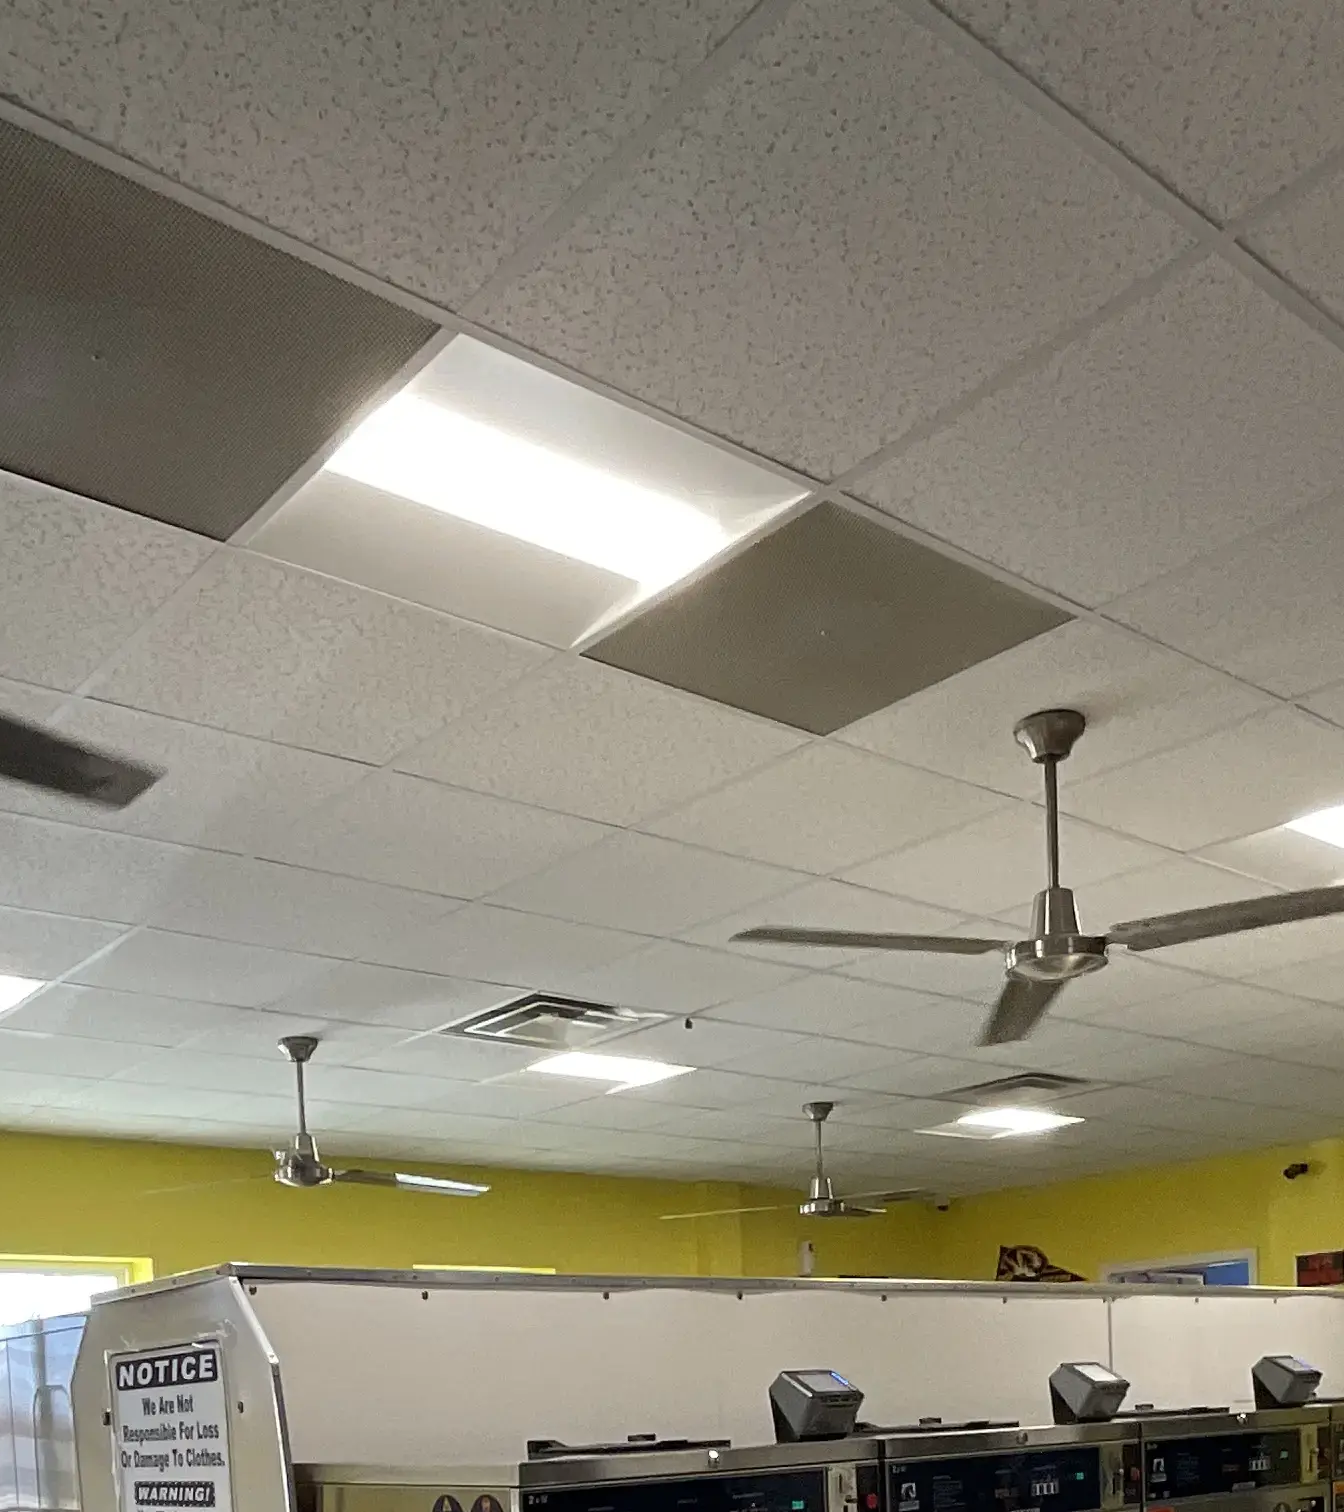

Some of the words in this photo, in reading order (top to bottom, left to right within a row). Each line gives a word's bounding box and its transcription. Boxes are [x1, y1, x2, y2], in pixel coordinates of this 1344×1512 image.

[119, 1354, 214, 1386] NOTICE
[142, 1398, 156, 1416] We
[159, 1396, 174, 1414] Are
[177, 1394, 194, 1412] Not
[123, 1422, 176, 1446] Responsible
[179, 1421, 194, 1440] For
[197, 1421, 219, 1439] Loss
[121, 1450, 131, 1468] Or
[134, 1450, 169, 1472] Damage
[172, 1449, 184, 1467] To
[186, 1448, 225, 1466] Clothes.
[138, 1487, 210, 1501] WARNING!
